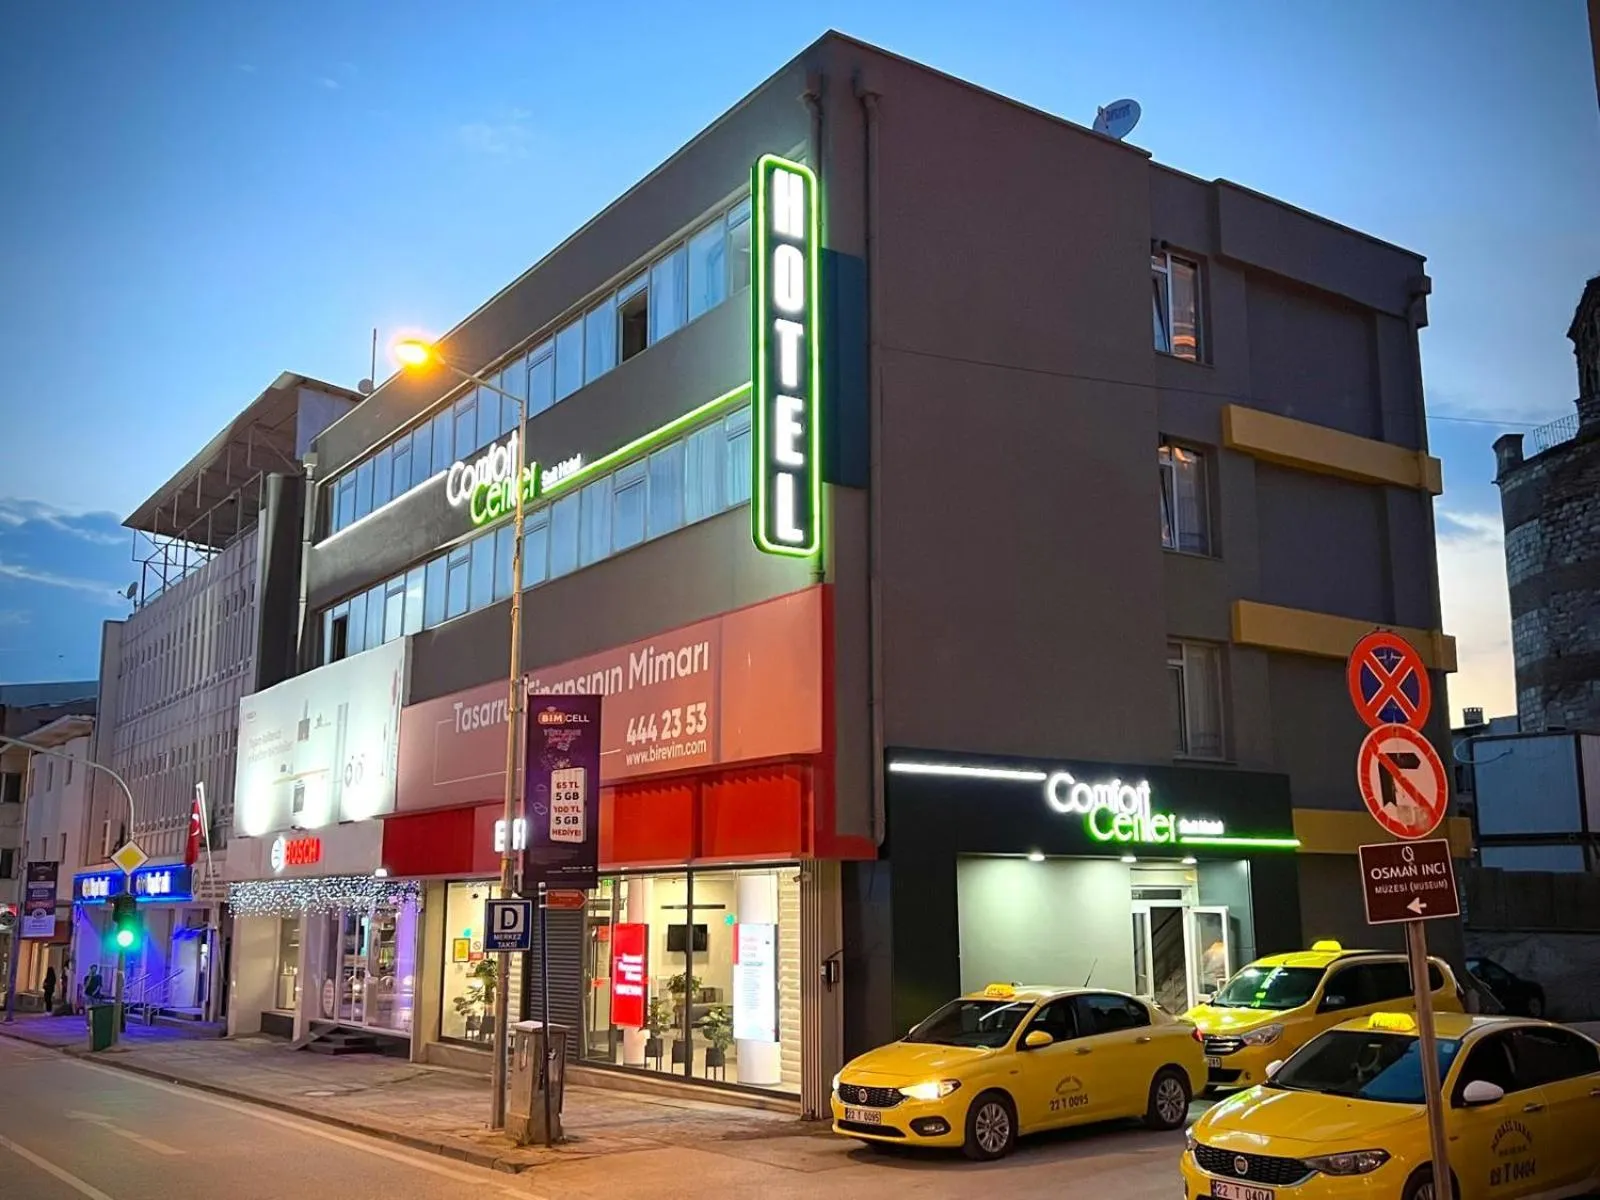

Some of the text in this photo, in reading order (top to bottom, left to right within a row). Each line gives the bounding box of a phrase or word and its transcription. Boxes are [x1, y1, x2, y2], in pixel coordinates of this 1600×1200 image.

[773, 168, 804, 542] HOTEL
[446, 430, 519, 506] Comfort
[453, 698, 513, 733] Tasarru
[629, 642, 708, 690] Mimarı
[627, 702, 707, 746] 444 23 53
[626, 739, 707, 766] www.birevim.com
[556, 792, 579, 800] 5 GB
[1047, 773, 1151, 819] Comfort
[555, 816, 579, 825] 5 GB
[1371, 864, 1418, 880] OSMAN
[501, 907, 518, 930] D
[1504, 1162, 1511, 1182] T
[1216, 1183, 1228, 1197] 22
[1235, 1187, 1240, 1199] T
